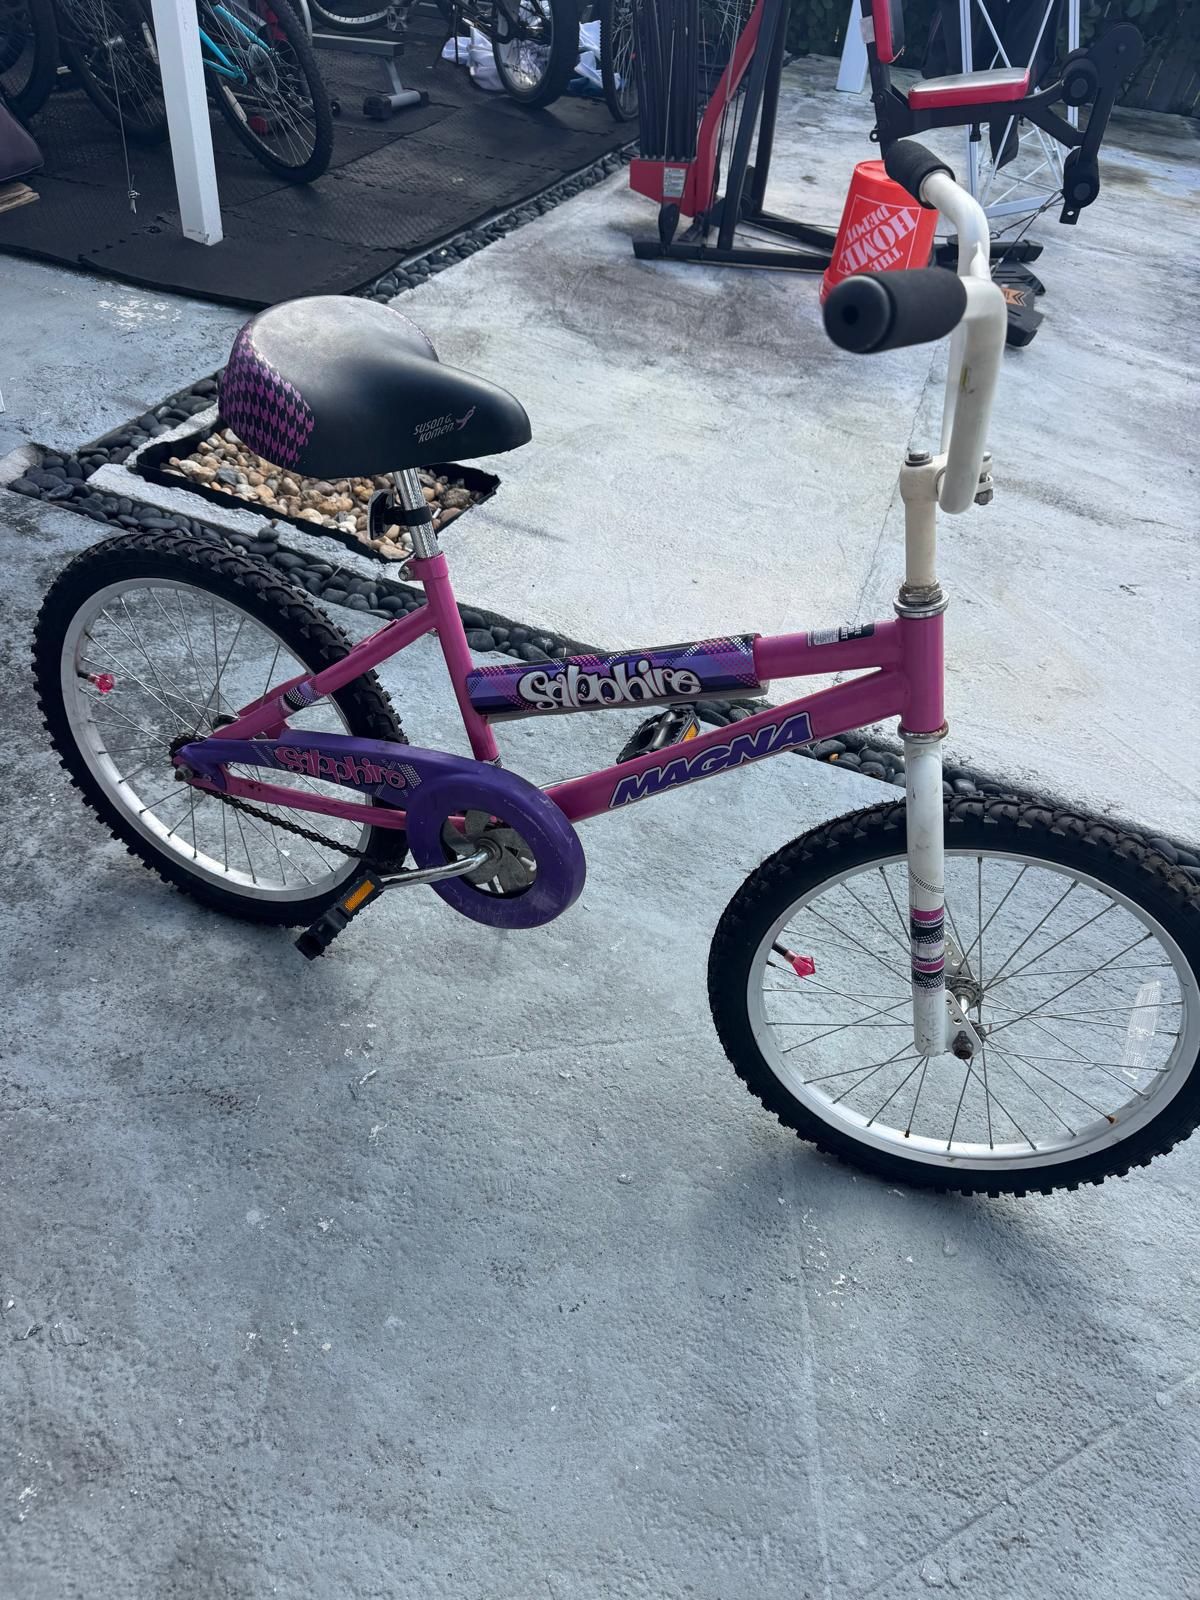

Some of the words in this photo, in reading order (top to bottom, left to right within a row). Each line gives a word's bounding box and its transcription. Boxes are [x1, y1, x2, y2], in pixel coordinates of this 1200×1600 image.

[841, 208, 917, 274] HOME
[846, 205, 890, 245] DEPOT
[868, 247, 904, 273] THE
[274, 746, 406, 789] Sapphire
[609, 712, 814, 809] MAGNA
